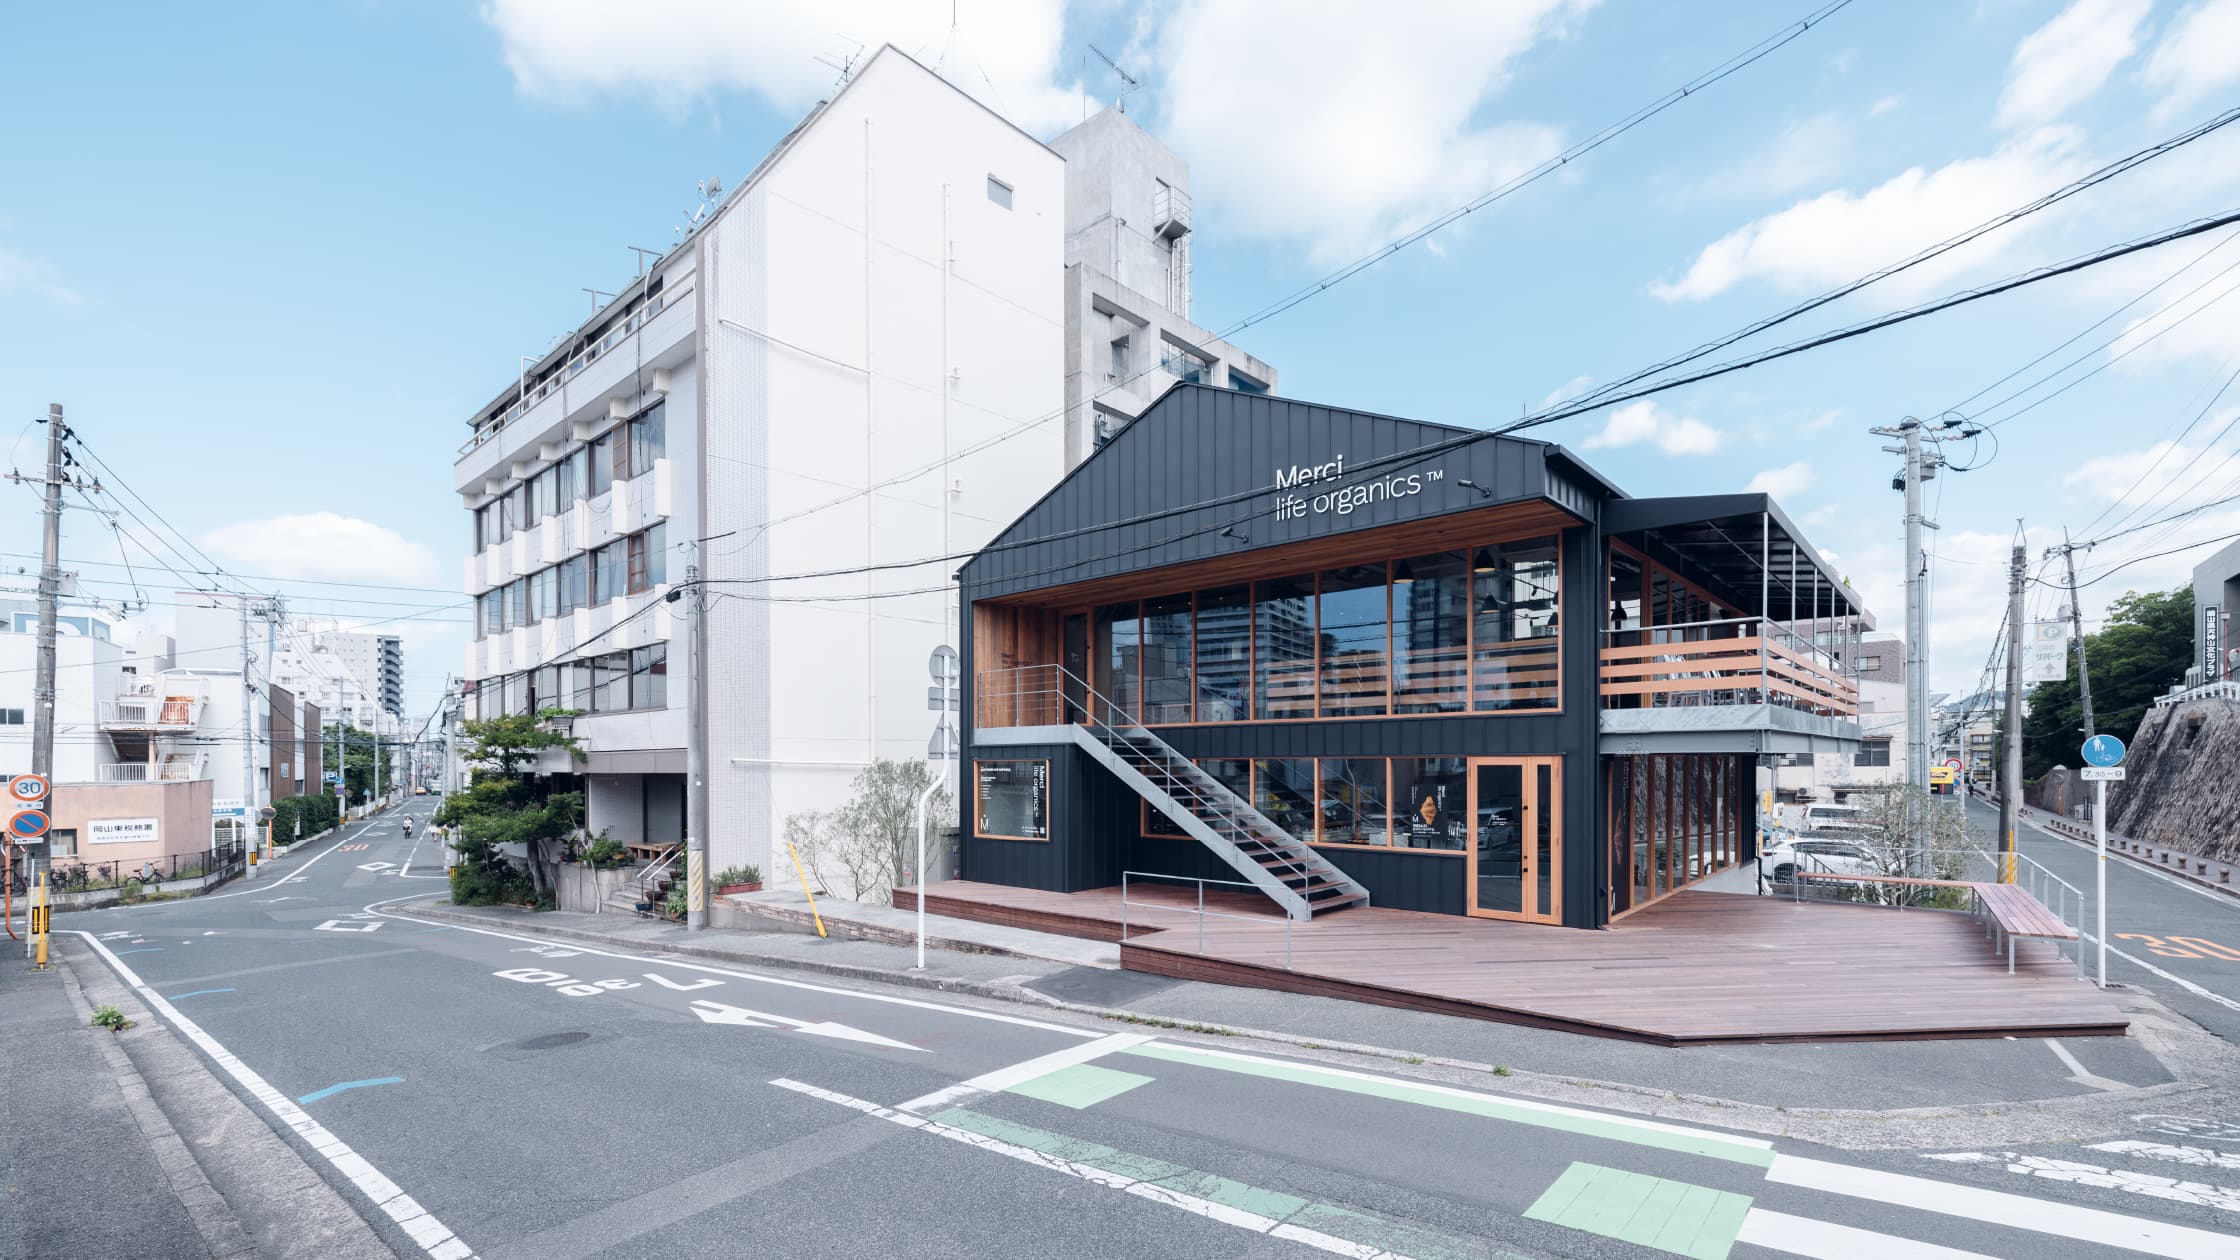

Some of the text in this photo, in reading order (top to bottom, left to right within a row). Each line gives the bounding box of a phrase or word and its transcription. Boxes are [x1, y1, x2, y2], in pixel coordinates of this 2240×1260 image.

[1276, 454, 1343, 491] Merci
[1276, 495, 1307, 521] life
[1313, 475, 1421, 515] organics
[19, 781, 41, 794] 30
